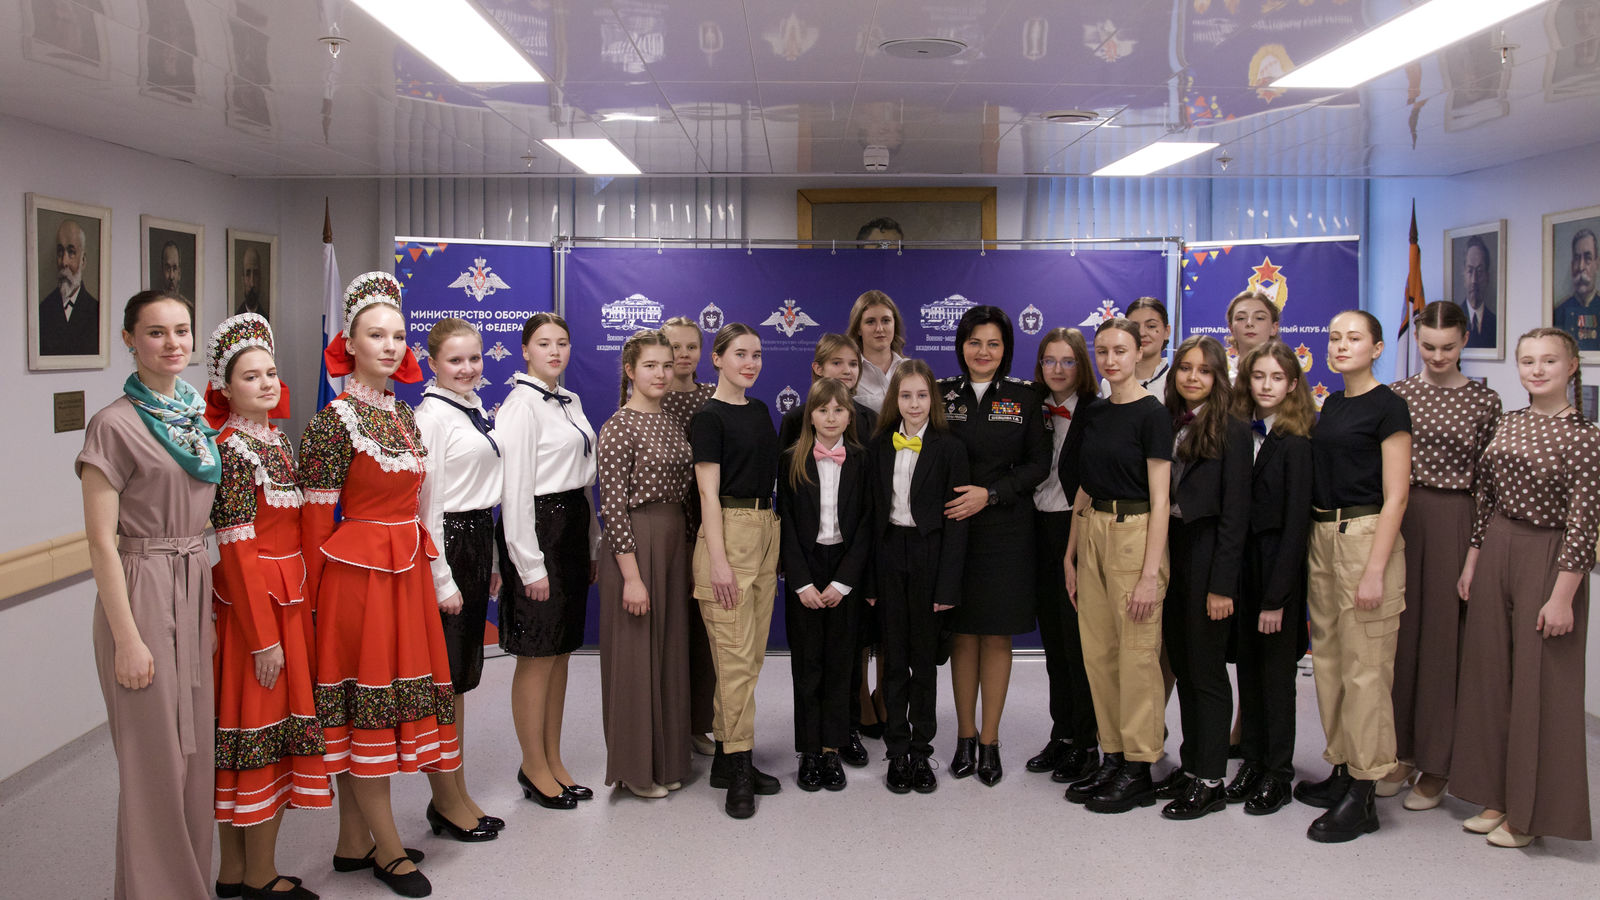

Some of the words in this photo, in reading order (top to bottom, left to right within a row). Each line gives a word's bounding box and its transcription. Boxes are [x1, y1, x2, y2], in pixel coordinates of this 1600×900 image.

[410, 310, 493, 320] МИНИСТЕРСТВО
[494, 310, 546, 320] ОБОРОН
[485, 322, 524, 333] ФЕДЕРА
[1190, 326, 1231, 334] ЦЕНТРАЛЬН
